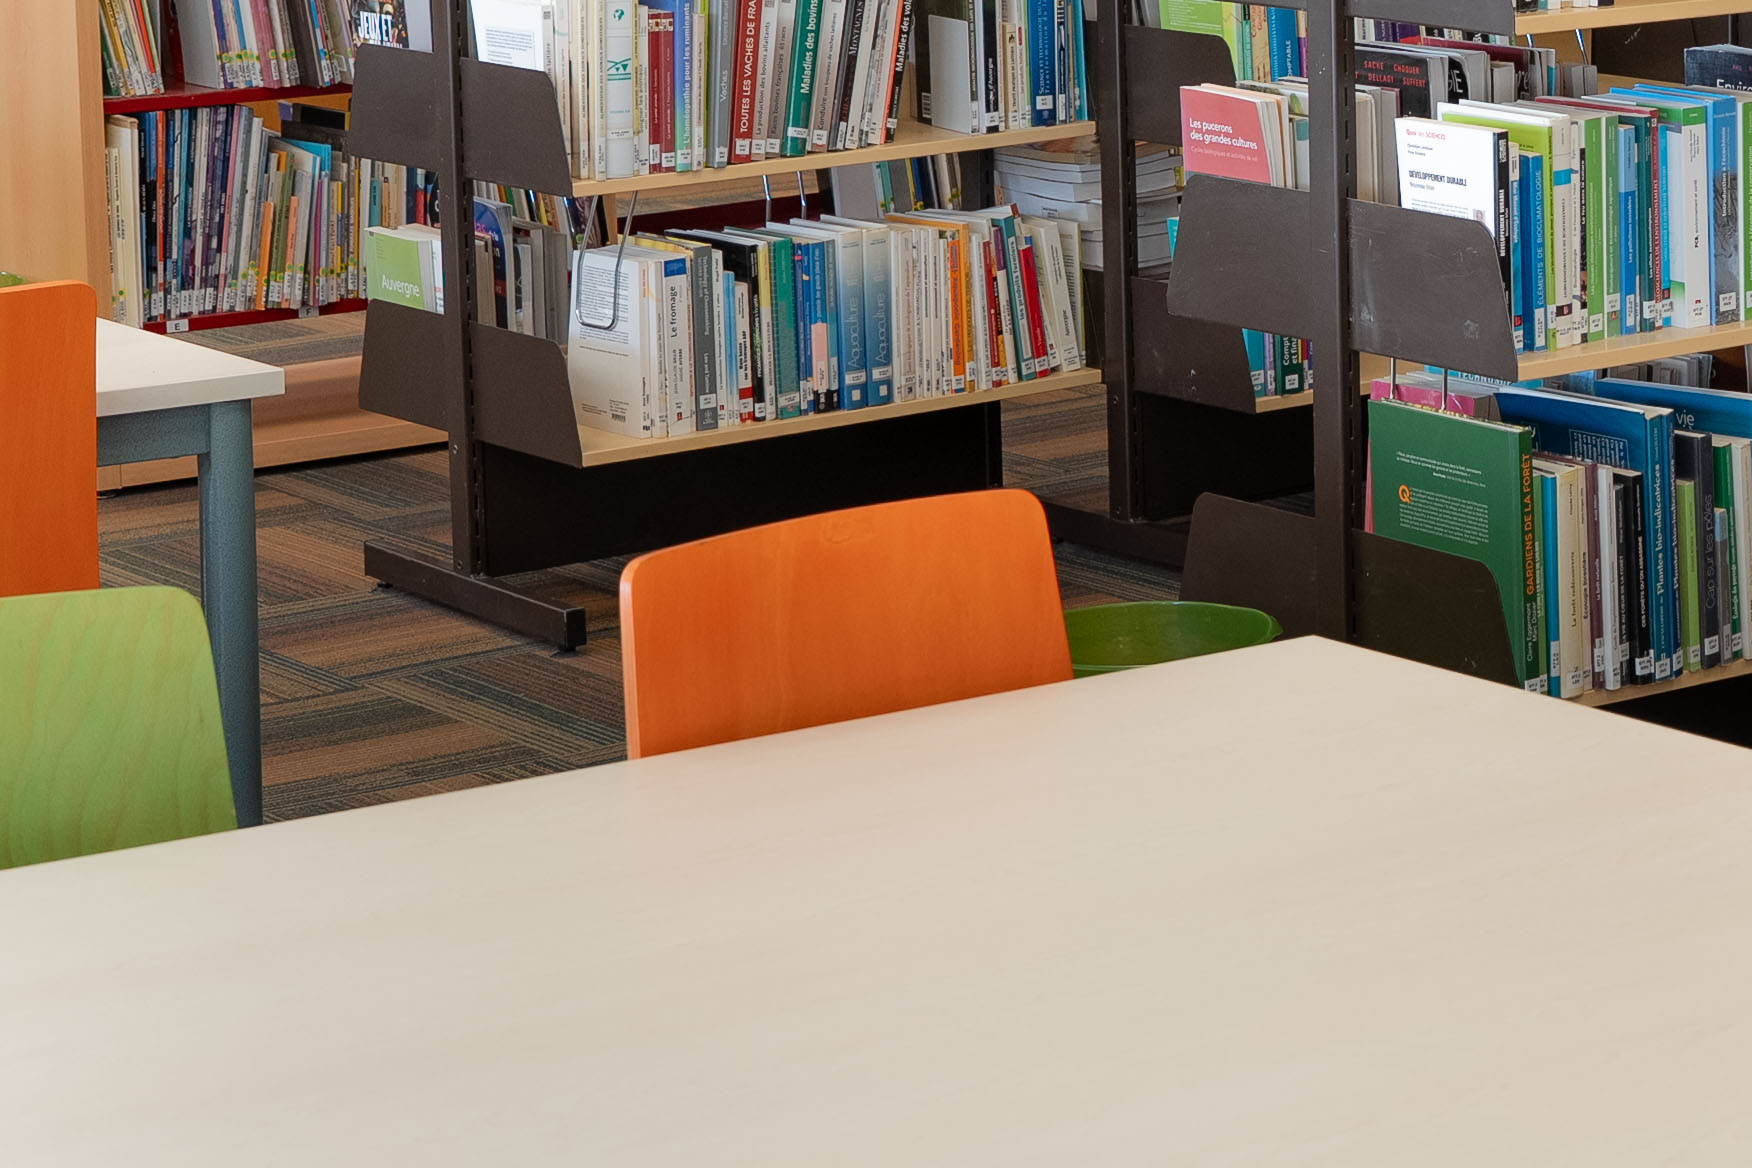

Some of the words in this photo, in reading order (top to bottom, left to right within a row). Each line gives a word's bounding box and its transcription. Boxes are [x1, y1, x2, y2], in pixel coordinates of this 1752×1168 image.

[807, 0, 818, 29] bovins
[900, 20, 910, 35] des
[746, 25, 755, 37] DE
[805, 32, 815, 48] des
[743, 41, 755, 79] VACHES
[895, 37, 907, 72] Maladies
[1364, 61, 1384, 71] SACHE
[1393, 63, 1420, 75] CHOQUER
[719, 69, 728, 101] Vaches
[801, 50, 813, 93] Maladies
[742, 82, 752, 98] LES
[683, 87, 691, 144] L'homéopathie
[740, 100, 751, 133] TOUTES
[1189, 118, 1201, 129] Les
[1203, 120, 1233, 135] pucerons
[1190, 130, 1202, 140] des
[1203, 133, 1228, 146] grandes
[1230, 136, 1258, 150] cultures
[1535, 170, 1543, 244] BIOCLIMATOLOGIE
[1536, 249, 1543, 259] DE
[381, 276, 420, 298] Auvergne
[1536, 263, 1544, 304] ÉLÉMENTS
[173, 321, 181, 331] E
[670, 326, 677, 338] Le
[848, 297, 860, 368] Aquaculture
[875, 296, 888, 364] Aquaculture
[1521, 454, 1532, 490] FORÊT
[1522, 493, 1532, 506] LA
[1654, 464, 1662, 546] bio-indicatrices
[1523, 509, 1533, 527] DE
[1703, 495, 1713, 536] pôles
[1704, 540, 1714, 557] les
[1524, 531, 1535, 594] GARDIENS
[1656, 554, 1664, 594] Plantes
[1704, 561, 1714, 579] sur
[1704, 583, 1716, 608] Cap
